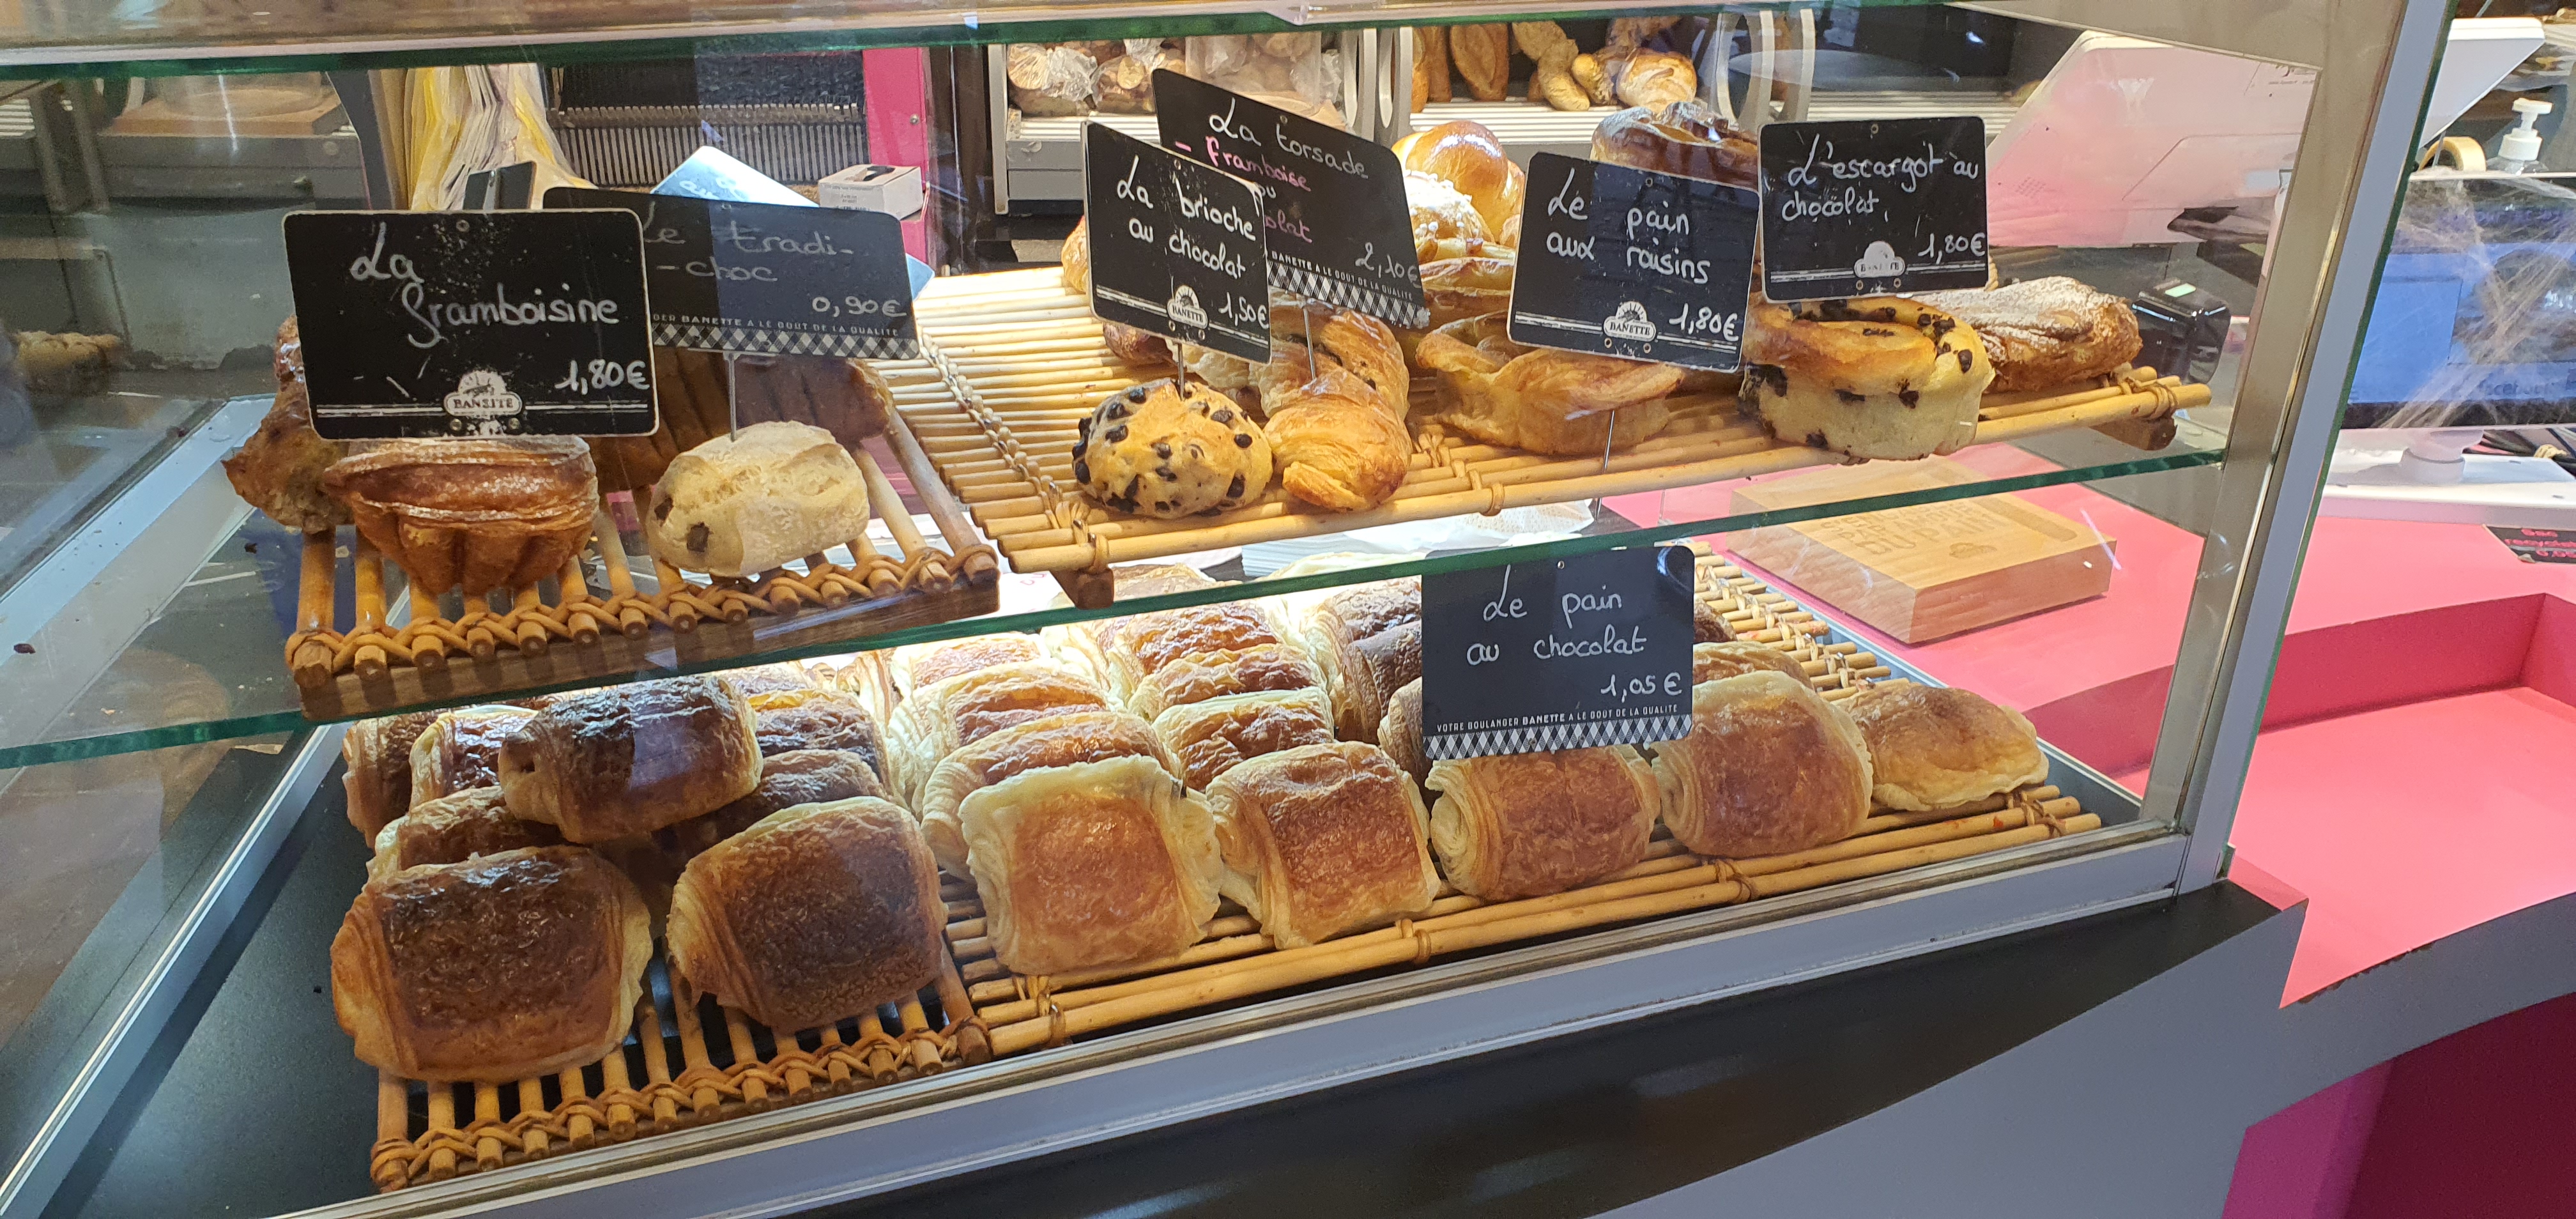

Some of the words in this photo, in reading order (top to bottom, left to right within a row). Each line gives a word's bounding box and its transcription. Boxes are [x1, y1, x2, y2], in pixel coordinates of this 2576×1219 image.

[1206, 135, 1312, 192] framboise
[1209, 97, 1262, 146] La
[1276, 124, 1368, 179] torsade
[1788, 133, 1944, 192] L'escargot
[1953, 160, 1979, 180] au
[1117, 155, 1153, 209] La
[1174, 176, 1256, 241] brioche
[1547, 168, 1589, 219] Le
[1626, 202, 1690, 243] pain
[349, 222, 425, 283] La
[730, 220, 855, 256] tradi-
[1128, 218, 1154, 242] au
[1169, 228, 1246, 279] chocolat
[1546, 232, 1595, 261] aux
[1626, 238, 1711, 284] raisins
[1917, 234, 1986, 264] 1,80€
[1355, 241, 1422, 288] 2,10€
[401, 282, 619, 348] framboisine
[811, 296, 907, 319] 0,90€
[1218, 292, 1269, 329] 1,50€
[1669, 303, 1739, 341] 1,80€
[554, 359, 650, 395] 1,80€
[1483, 565, 1528, 622] Le
[1561, 584, 1621, 629] pain
[1466, 643, 1499, 665] au
[1533, 624, 1647, 659] chocolat
[1437, 722, 1464, 732] VOTRE
[1522, 713, 1565, 725] BANETTE
